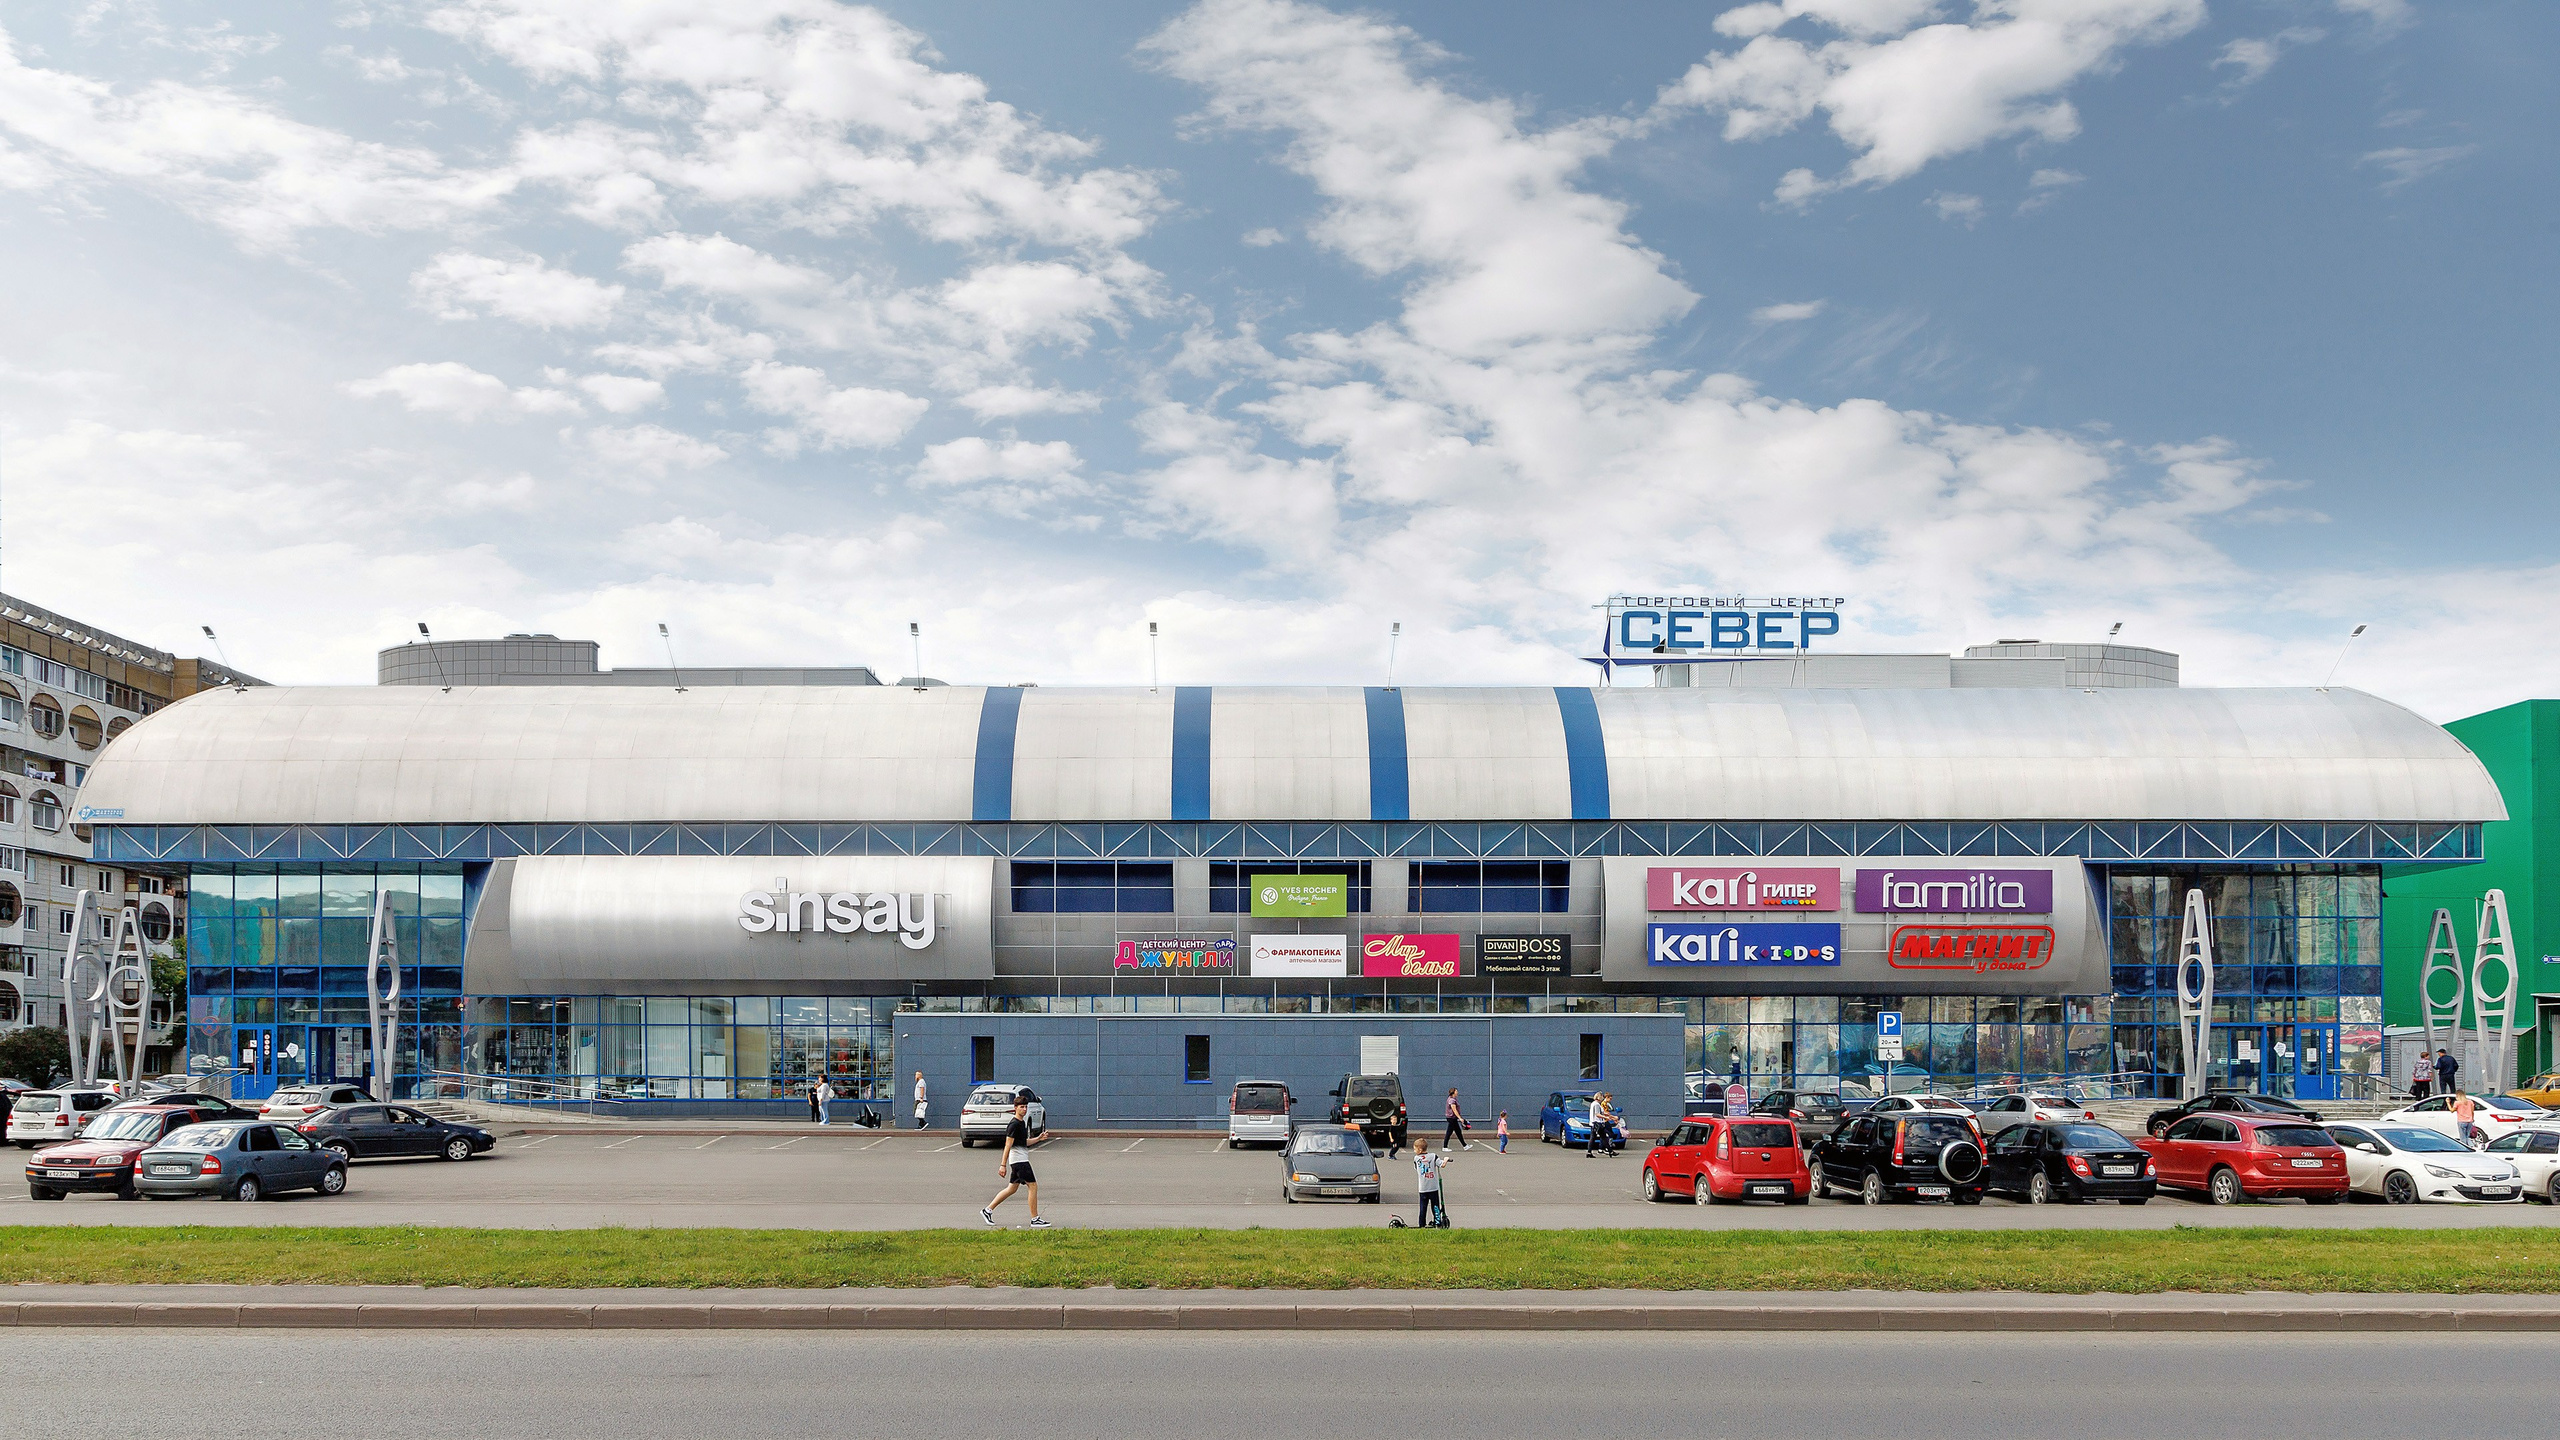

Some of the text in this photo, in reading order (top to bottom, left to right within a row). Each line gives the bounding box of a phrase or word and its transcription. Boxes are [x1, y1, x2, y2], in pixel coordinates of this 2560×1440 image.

[1621, 593, 1846, 608] ТОРГОВЫЙ ЦЕНТР
[1621, 610, 1840, 649] СЕВЕР
[1280, 886, 1338, 894] YVES ROCHER
[1672, 871, 1818, 906] kari ГИПЕР
[1882, 872, 2027, 909] familia
[738, 876, 936, 950] sinsay
[1113, 940, 1234, 970] ДЖУНГЛИ
[1141, 939, 1207, 949] ДЕТСКИЙ ЦЕНТР
[1214, 940, 1236, 950] ПАРК
[1270, 947, 1342, 956] ФАРМАКОПЕЙКА
[1364, 934, 1425, 958] Мир
[1486, 939, 1561, 953] DIVAN BOSS
[1654, 926, 1739, 962] kari
[1900, 934, 2046, 959] МАГНИТ
[1401, 956, 1455, 976] белья
[1975, 958, 2028, 974] у дома
